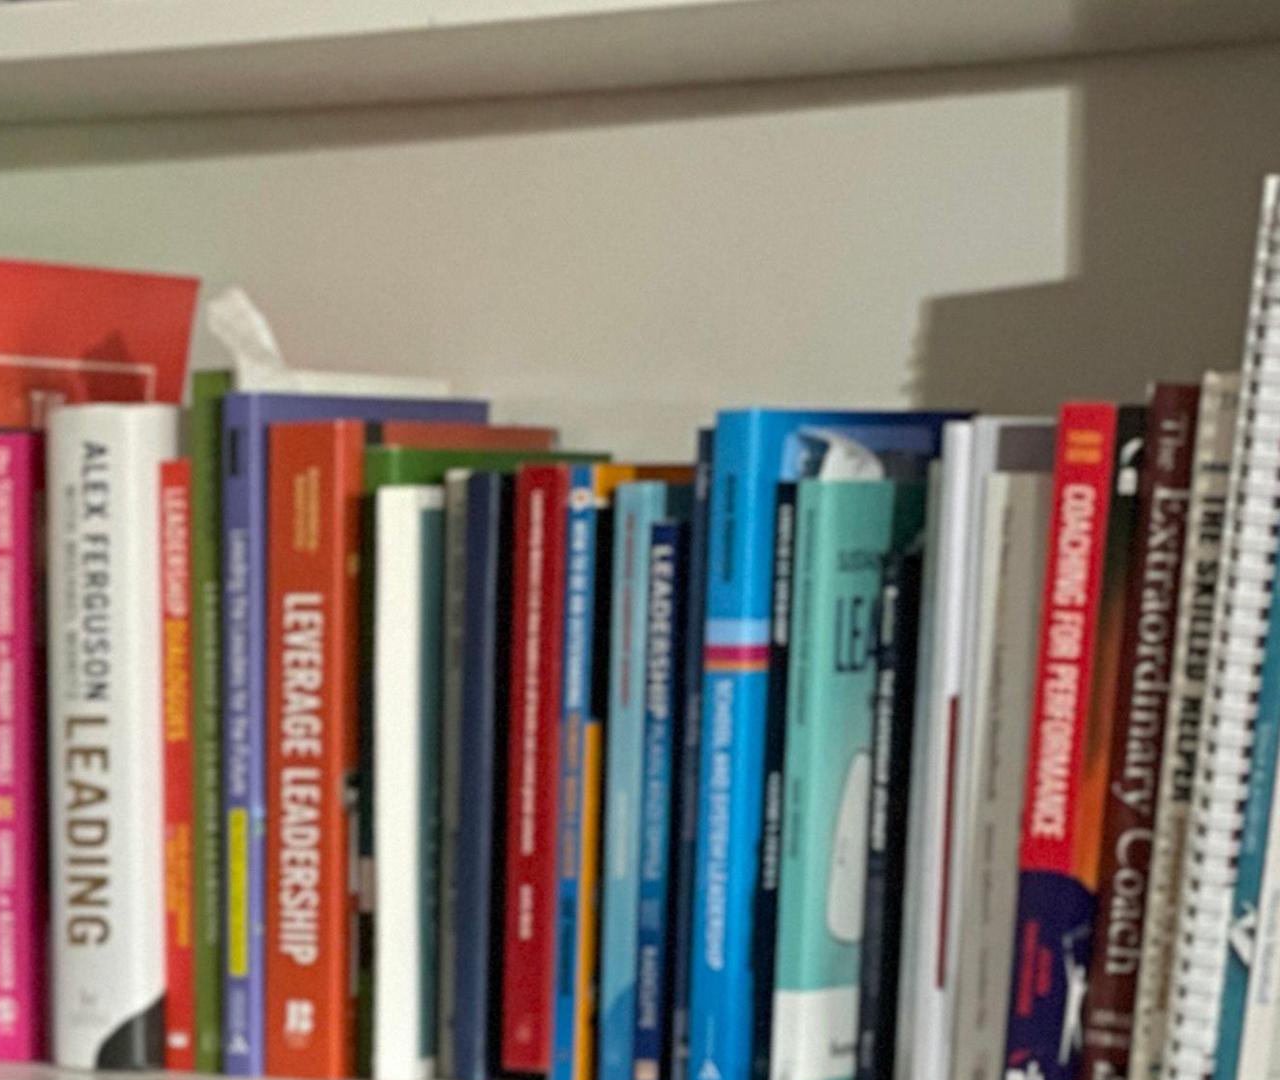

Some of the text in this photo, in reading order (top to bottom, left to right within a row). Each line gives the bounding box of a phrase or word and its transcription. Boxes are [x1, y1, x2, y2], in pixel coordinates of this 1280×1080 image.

[81, 441, 111, 702] ALEX FERGUSON
[163, 486, 188, 618] LEADERSHIP
[228, 529, 249, 591] Leading
[1053, 482, 1096, 607] COACHING
[231, 626, 249, 687] Leaders
[282, 592, 323, 755] LEVERAGE
[646, 544, 676, 720] LEADERSHIP
[1047, 609, 1086, 660] FOR
[1111, 487, 1191, 805] Extraordinary
[1185, 558, 1223, 684] SKILLED
[231, 744, 249, 795] Future
[1030, 664, 1079, 841] PERFORMANCE
[1173, 696, 1209, 803] HELPER
[65, 717, 111, 947] LEADING
[279, 767, 322, 965] LEADERSHIP
[1104, 828, 1154, 976] Coach
